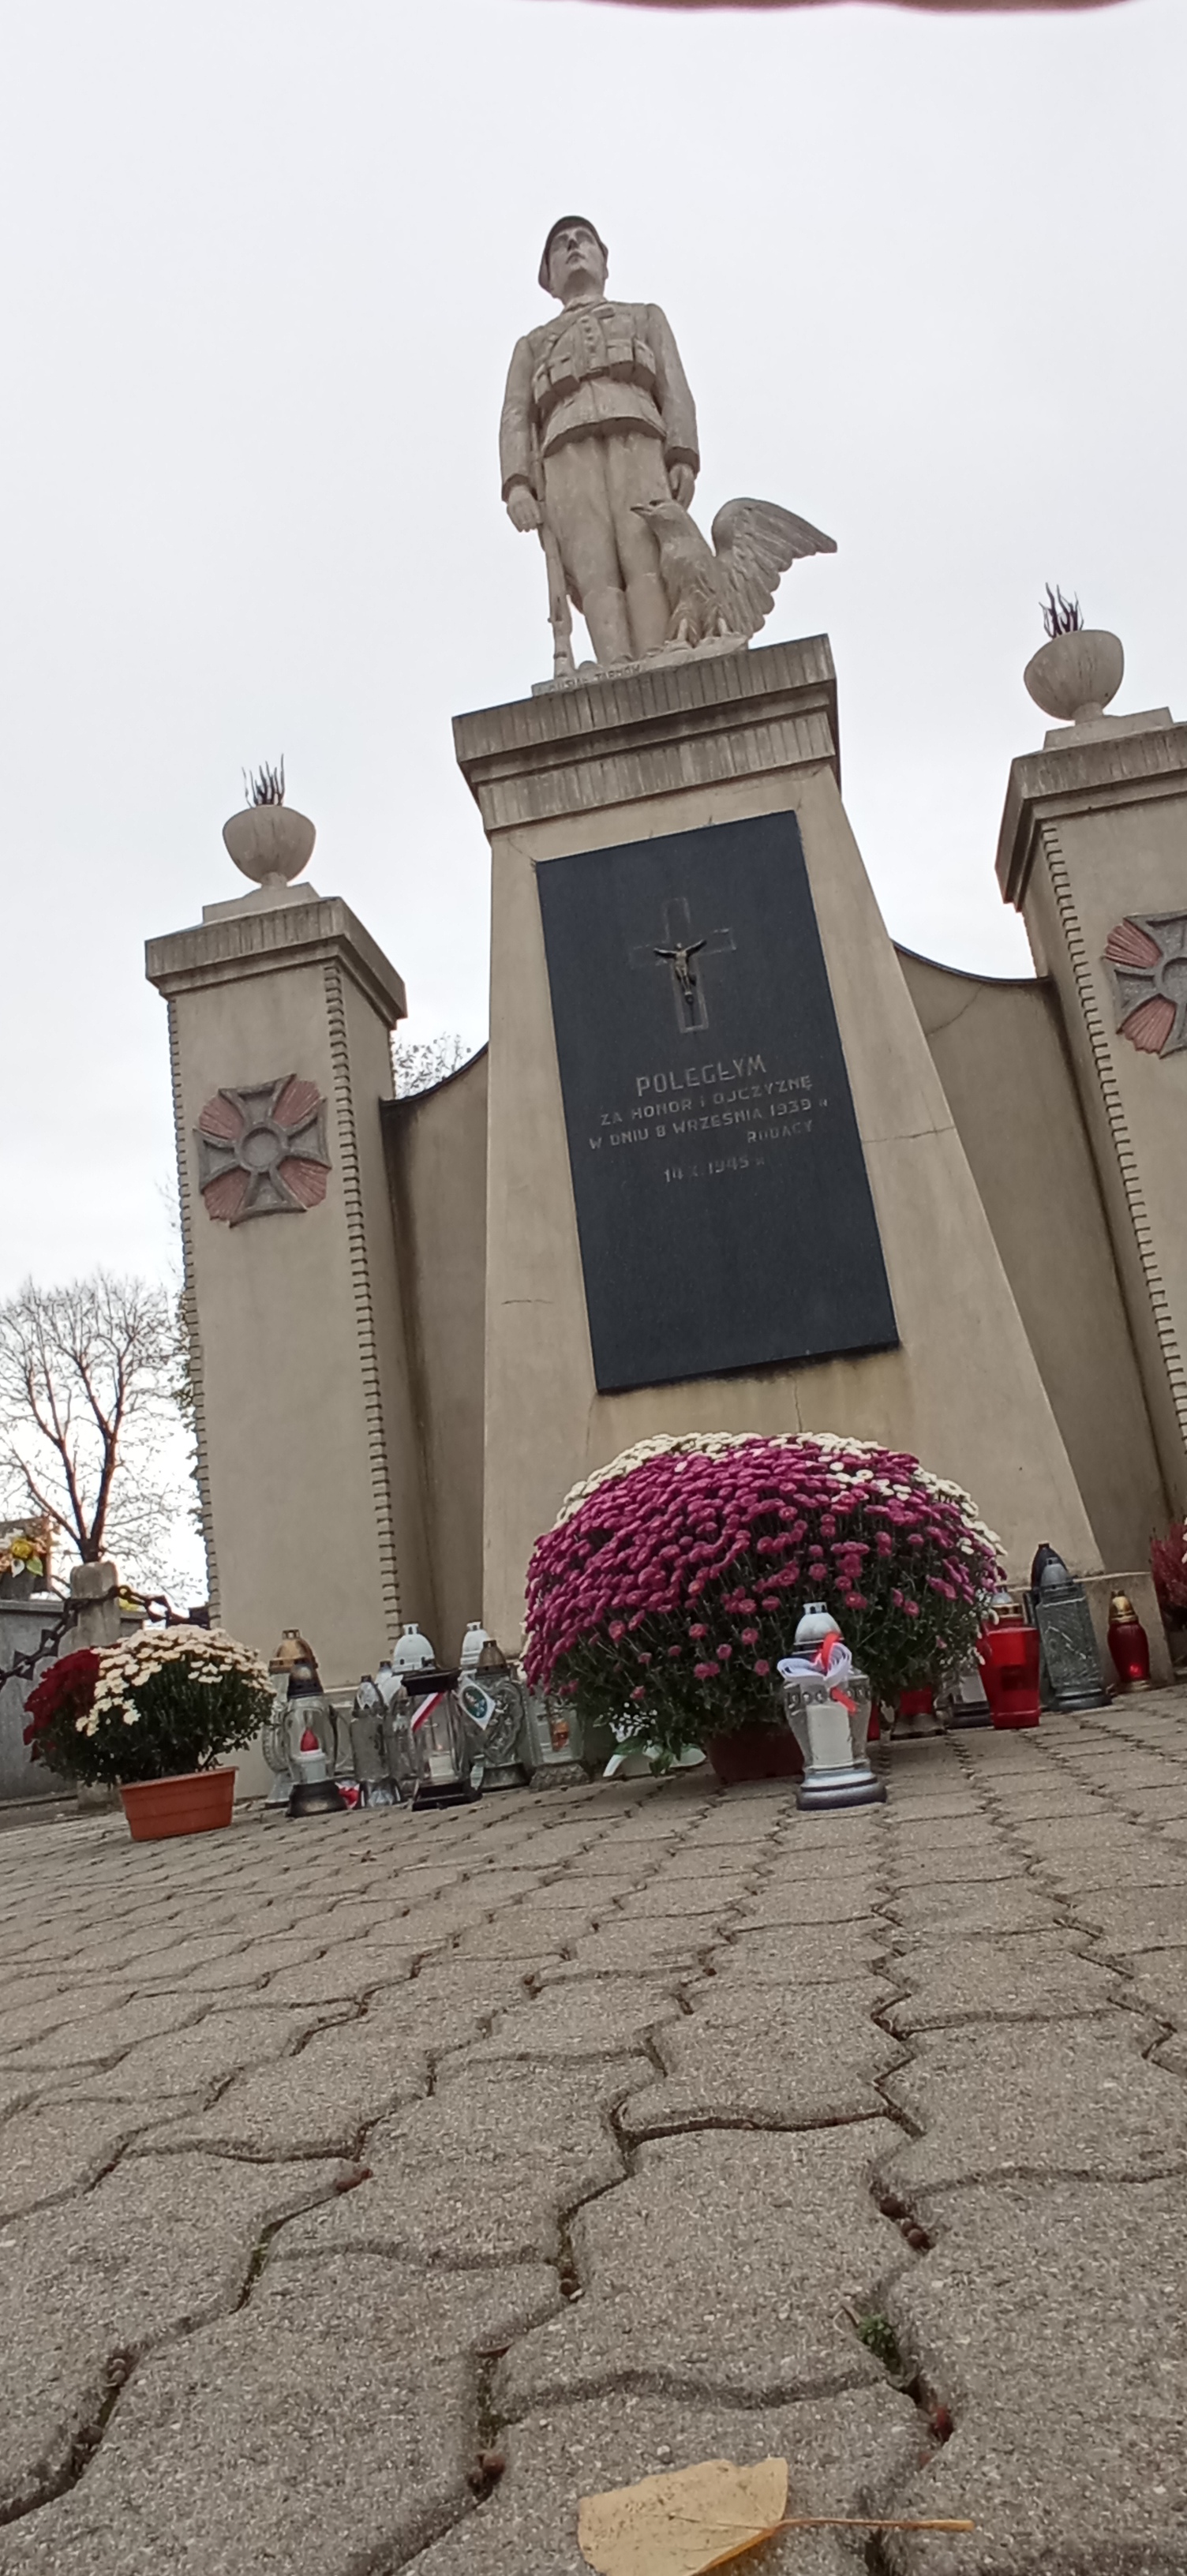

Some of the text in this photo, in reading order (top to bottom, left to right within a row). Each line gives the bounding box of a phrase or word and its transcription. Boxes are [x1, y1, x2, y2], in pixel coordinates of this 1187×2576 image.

[636, 1054, 767, 1096] POLEGŁYM
[589, 1136, 602, 1149] W
[609, 1128, 649, 1146] DNIU
[769, 1099, 812, 1117] 1939
[601, 1112, 623, 1126] ZA
[632, 1099, 692, 1120] HONOR
[713, 1075, 813, 1104] OJCZYZNĘ
